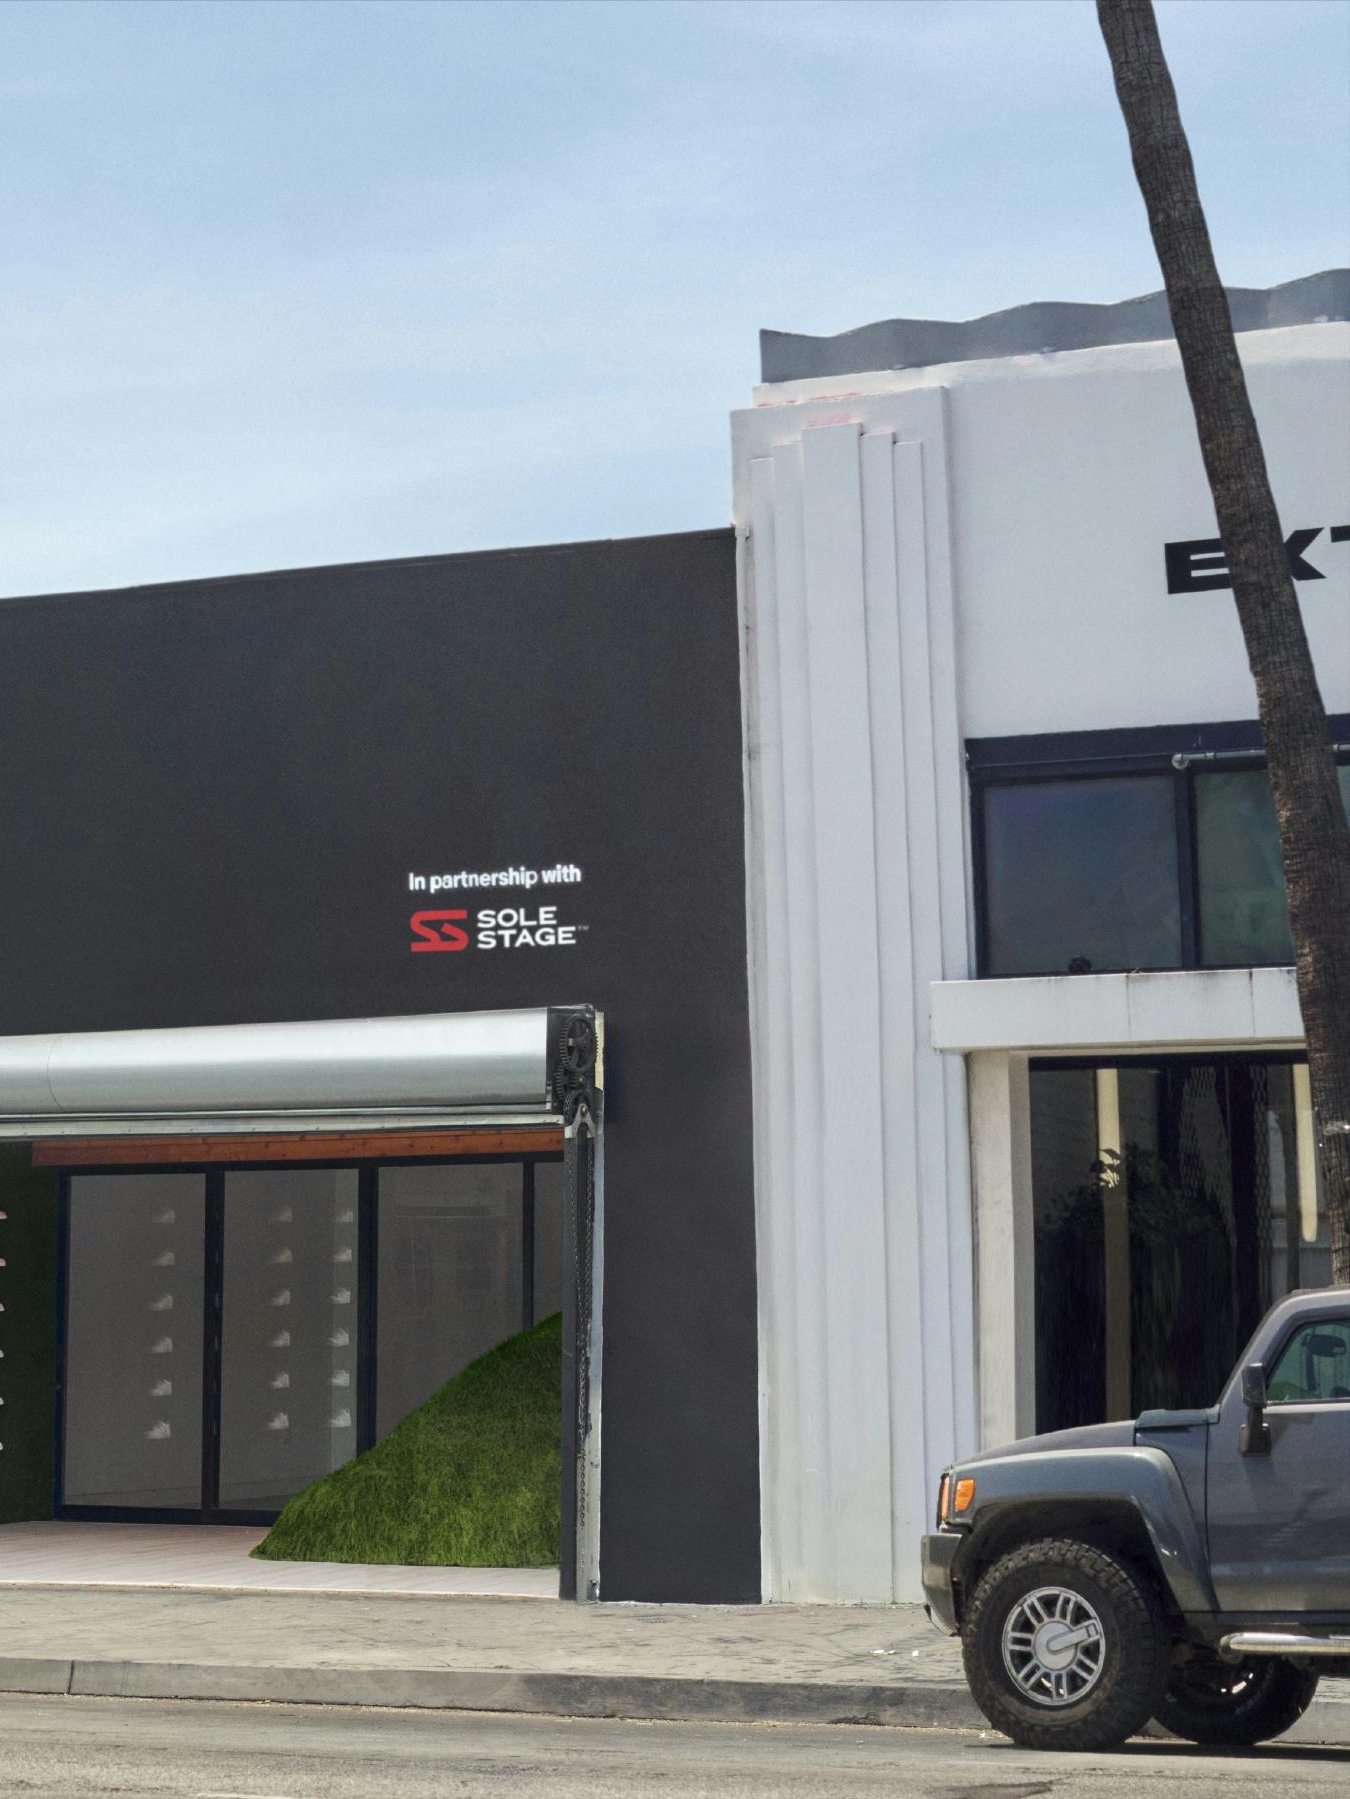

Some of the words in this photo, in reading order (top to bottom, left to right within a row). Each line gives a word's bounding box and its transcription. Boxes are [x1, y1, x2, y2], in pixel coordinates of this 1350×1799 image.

[409, 872, 426, 891] In
[430, 866, 538, 894] partnership
[541, 864, 582, 884] with
[476, 906, 558, 928] SOLE
